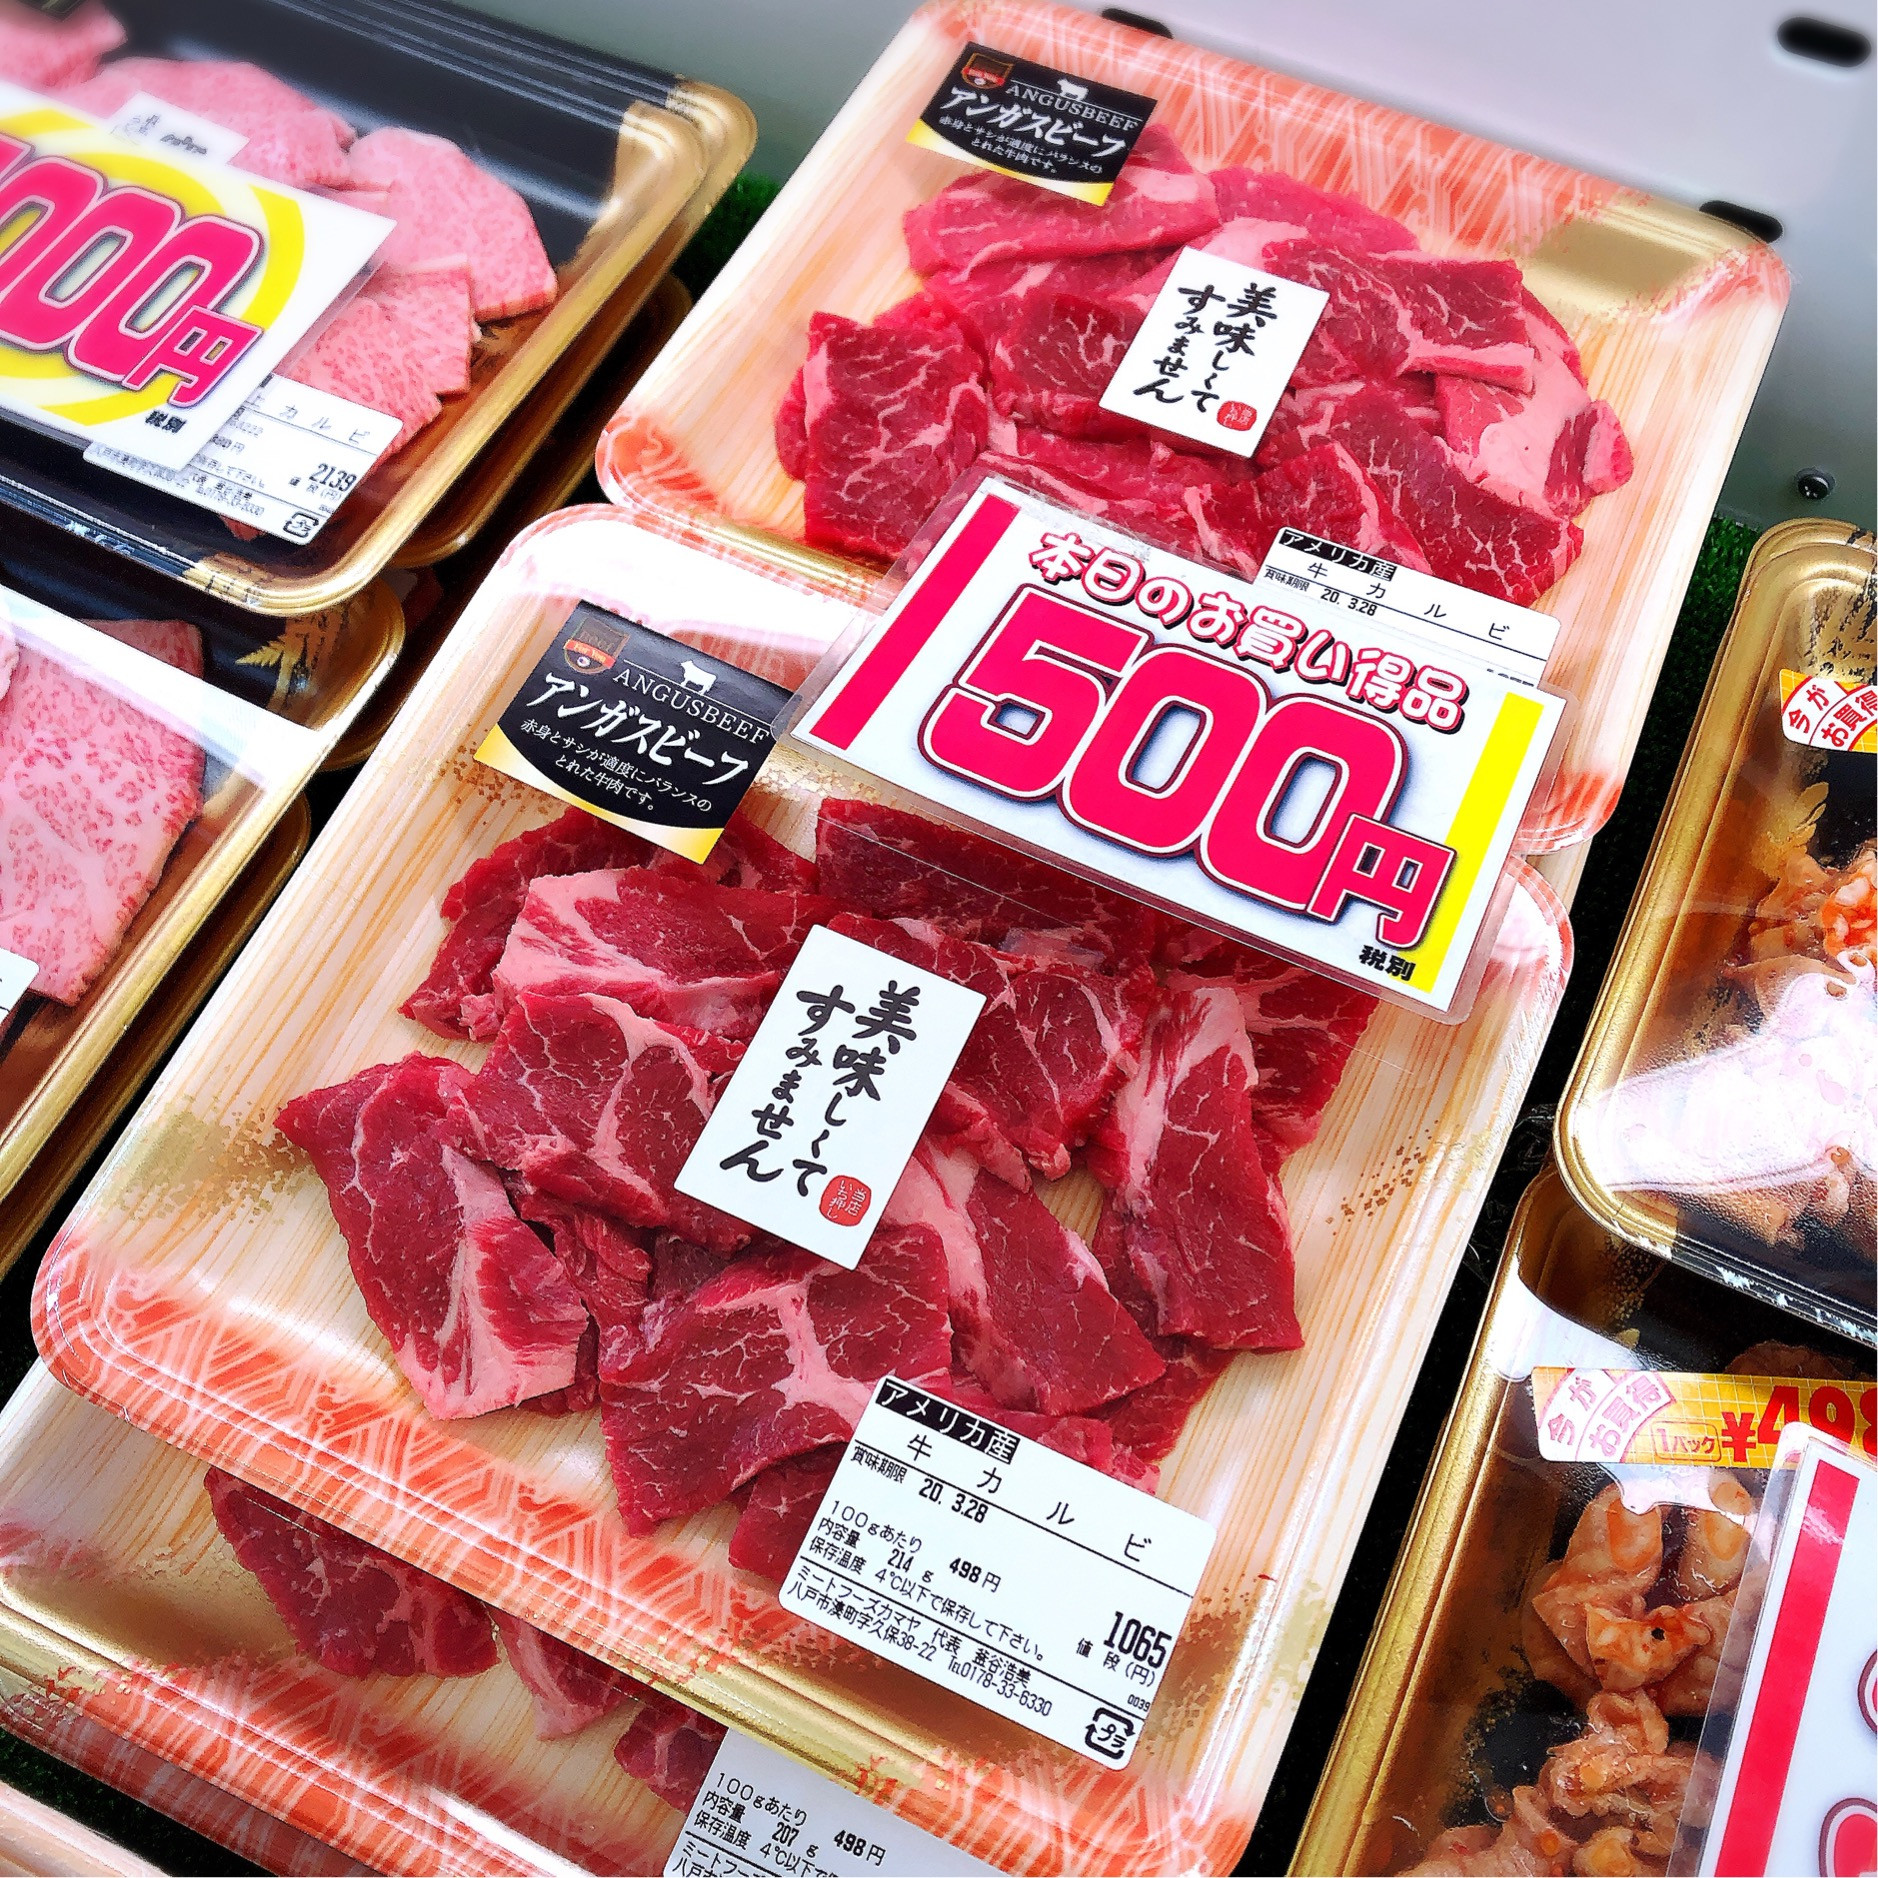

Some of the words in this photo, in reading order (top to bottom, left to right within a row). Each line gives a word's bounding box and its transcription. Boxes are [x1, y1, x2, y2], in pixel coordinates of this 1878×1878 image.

[940, 86, 1126, 157] アンガスビーフ
[1005, 83, 1139, 132] ANGUSBEEF
[1133, 284, 1226, 404] すみません
[309, 463, 357, 493] 2139
[1282, 532, 1395, 581] アメリカ産
[1028, 532, 1473, 735] 本日のお買い得品
[526, 672, 749, 785] アンガスビーフ
[612, 668, 770, 745] ANGUSBEEF
[1788, 684, 1829, 734] 今が
[520, 718, 712, 813] 赤身とサシが適度にバランスの
[554, 754, 654, 811] とれた牛肉です。
[1359, 944, 1416, 981] 税別
[720, 985, 856, 1182] すみません
[881, 1382, 1018, 1462] アメリカ産
[1547, 1375, 1597, 1445] 今が
[1589, 1375, 1662, 1458] お買得
[850, 1445, 908, 1484] 賞味期限
[1655, 1428, 1717, 1454] 1パック
[817, 1517, 861, 1549] 内容量
[888, 1549, 914, 1573] 214
[832, 1500, 922, 1553] 100gあたり
[809, 1535, 867, 1575] 保存温度
[930, 1628, 962, 1655] 代表
[1103, 1611, 1172, 1669] 1065
[1127, 1694, 1151, 1712] 0039
[702, 1790, 746, 1824] 内容量
[771, 1822, 799, 1848] 207
[717, 1773, 807, 1827] 100gあたり
[694, 1809, 752, 1851] 保存温度
